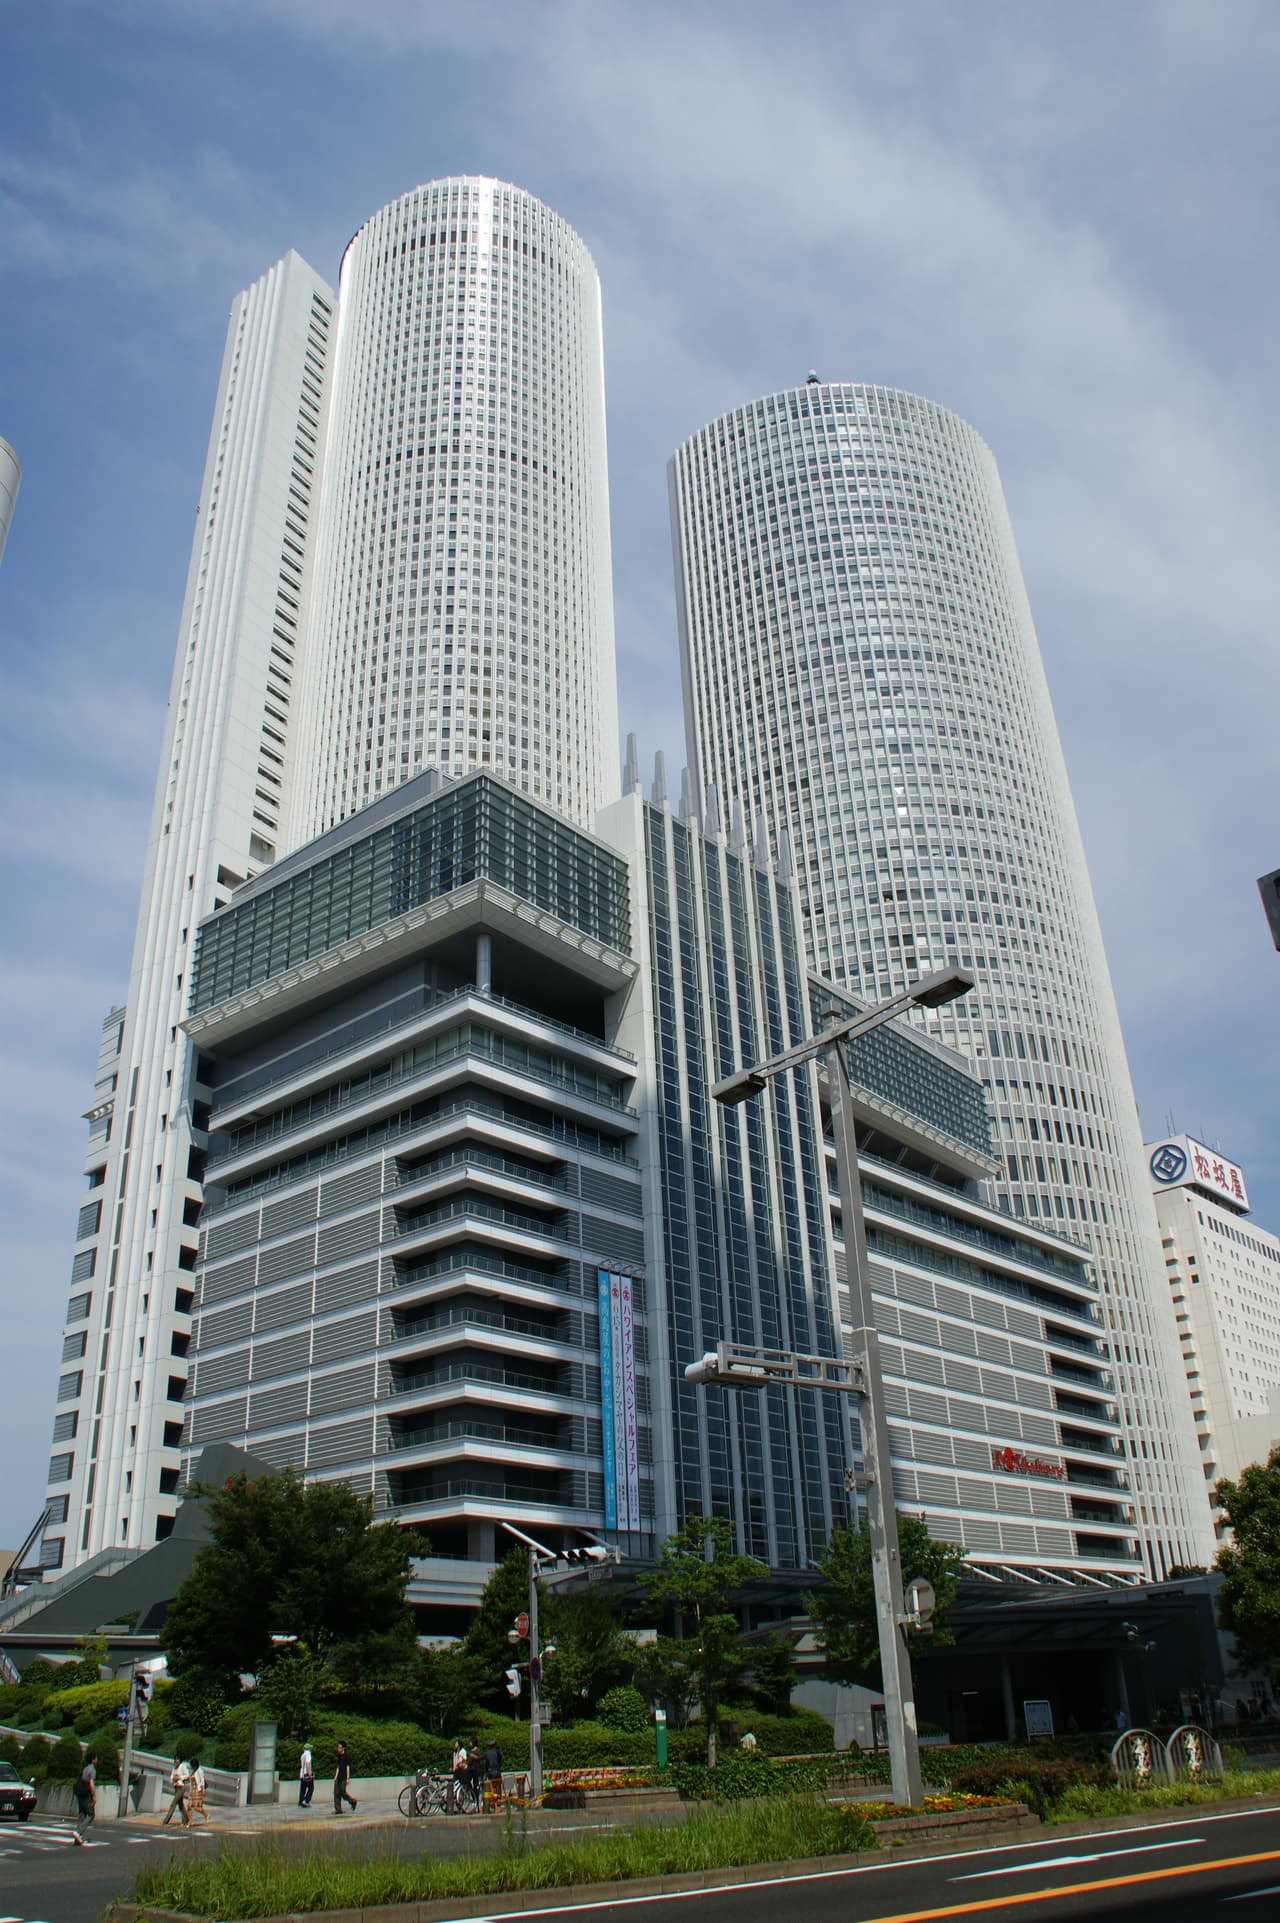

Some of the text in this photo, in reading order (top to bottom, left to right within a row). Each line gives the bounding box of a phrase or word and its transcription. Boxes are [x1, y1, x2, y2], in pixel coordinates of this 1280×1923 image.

[1194, 1145, 1244, 1200] 松坂屋
[624, 1305, 636, 1475] ハワイアンスペシャルフェア
